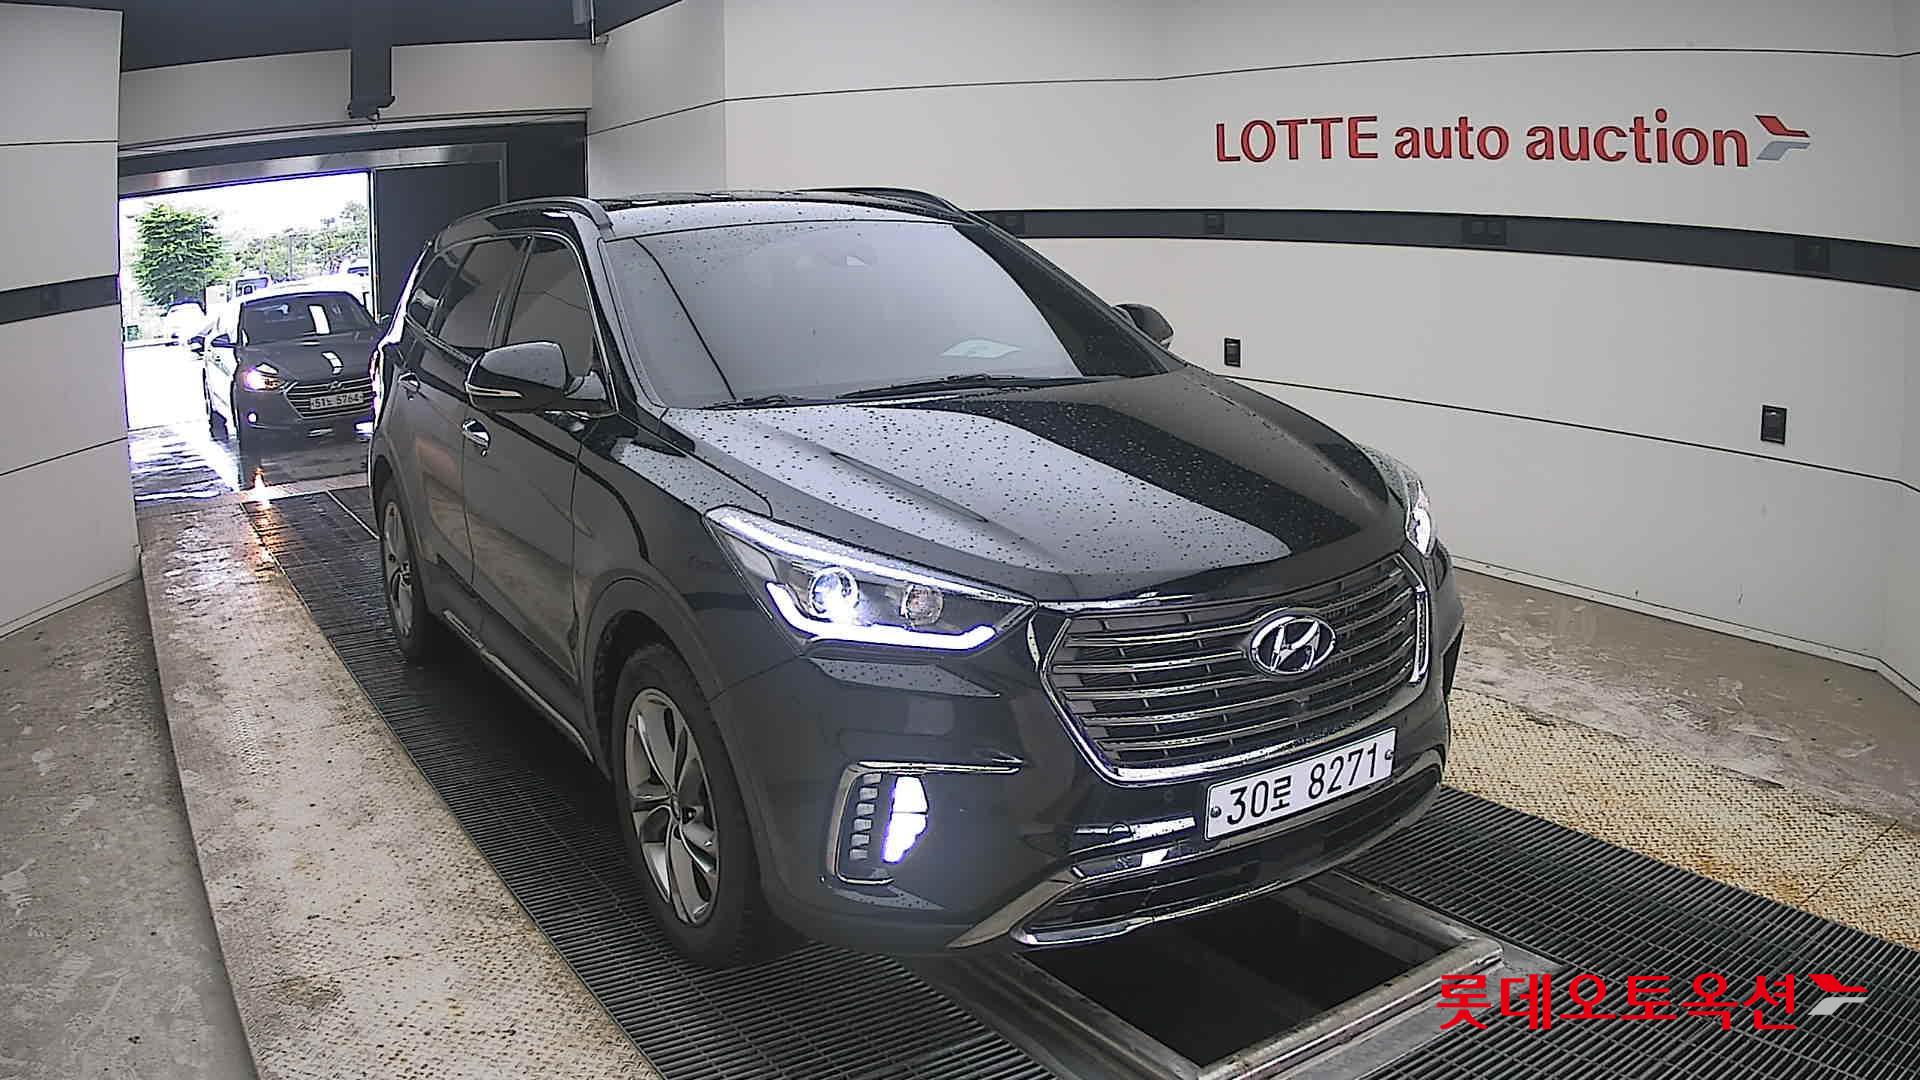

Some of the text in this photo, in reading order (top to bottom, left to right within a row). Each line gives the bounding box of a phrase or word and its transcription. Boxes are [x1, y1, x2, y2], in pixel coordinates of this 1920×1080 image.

[1215, 108, 1750, 168] LOTTE auto auction
[1226, 742, 1378, 826] 30로 8271
